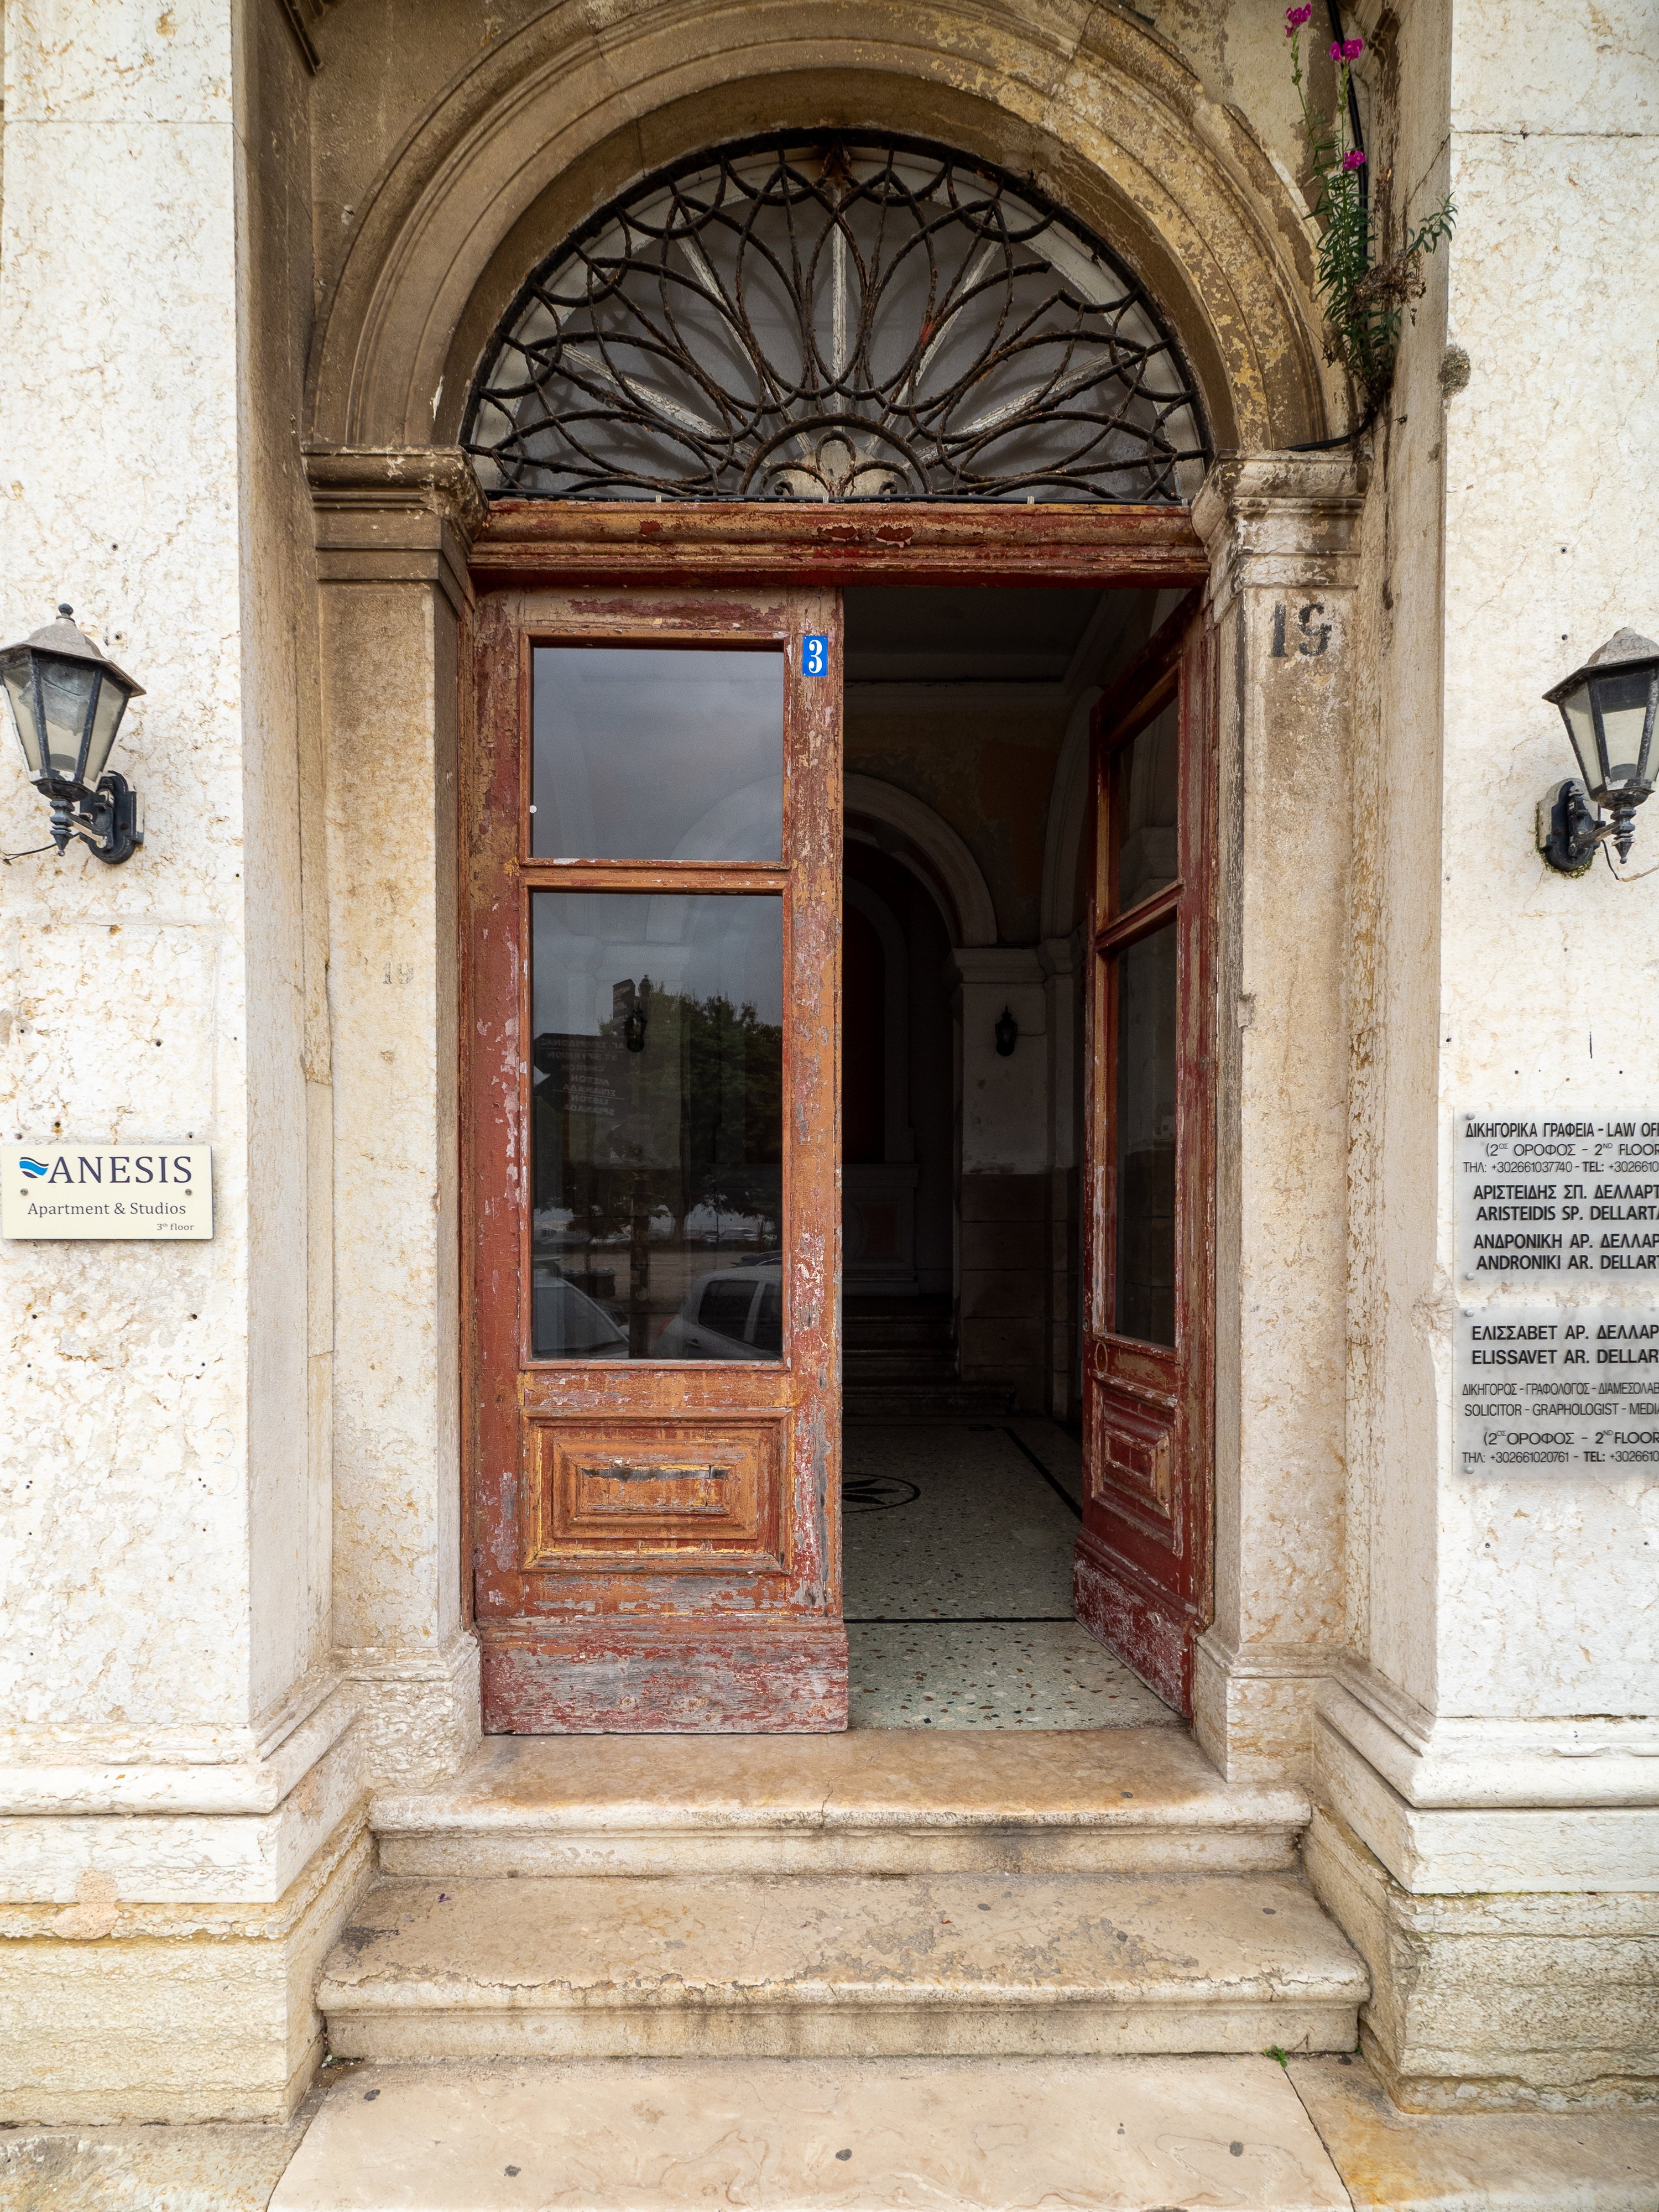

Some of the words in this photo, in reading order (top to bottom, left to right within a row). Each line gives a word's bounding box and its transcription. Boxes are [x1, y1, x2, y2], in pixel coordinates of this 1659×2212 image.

[808, 639, 823, 674] 3
[1465, 1122, 1538, 1138] ΔΙΚΗΓΟΡΙΚΑ
[1543, 1123, 1595, 1138] ΓΡΑΦΕΙΑ
[1607, 1123, 1636, 1138] LAW
[1514, 1144, 1576, 1156] ΟΡΟΦΟΣ
[48, 1156, 192, 1183] ANESIS
[1463, 1161, 1487, 1173] ΤΗΛ:
[1491, 1161, 1573, 1173] +302661037740
[1582, 1161, 1604, 1172] TEL:
[1473, 1185, 1557, 1200] ΑΡΙΣΤΕΙΔΗΣ
[1563, 1185, 1587, 1199] ΣΠ.
[28, 1203, 109, 1217] Apartment
[114, 1203, 125, 1214] &
[130, 1202, 186, 1214] Studios
[1475, 1206, 1556, 1221] ARISTEIDIS
[1562, 1206, 1583, 1220] SP.
[1590, 1206, 1659, 1220] DELLART
[1473, 1233, 1562, 1249] ΑΝΔΡΟΝΙΚΗ
[1569, 1233, 1593, 1249] ΑΡ.
[1475, 1255, 1561, 1270] ANDRONIKI
[1567, 1255, 1593, 1270] AR.
[1472, 1325, 1558, 1340] ΕΛΙΣΣΑΒΕΤ
[1564, 1325, 1589, 1340] ΑΡ.
[1472, 1349, 1558, 1365] ELISSAVET
[1563, 1349, 1590, 1364] AR.
[1462, 1383, 1517, 1396] ΔΙΚΗΓΟΡΟΣ
[1526, 1382, 1590, 1395] ΓΡΑΦΟΛΟΓΟΣ
[1464, 1404, 1522, 1417] SOLICITOR
[1532, 1402, 1620, 1416] GRAPHOLOGIST
[1507, 1432, 1575, 1445] ΟΡΟΦΟΣ
[1462, 1452, 1486, 1463] ΤΗΛ:
[1490, 1451, 1569, 1463] +302661020761
[1583, 1451, 1605, 1462] TEL:
